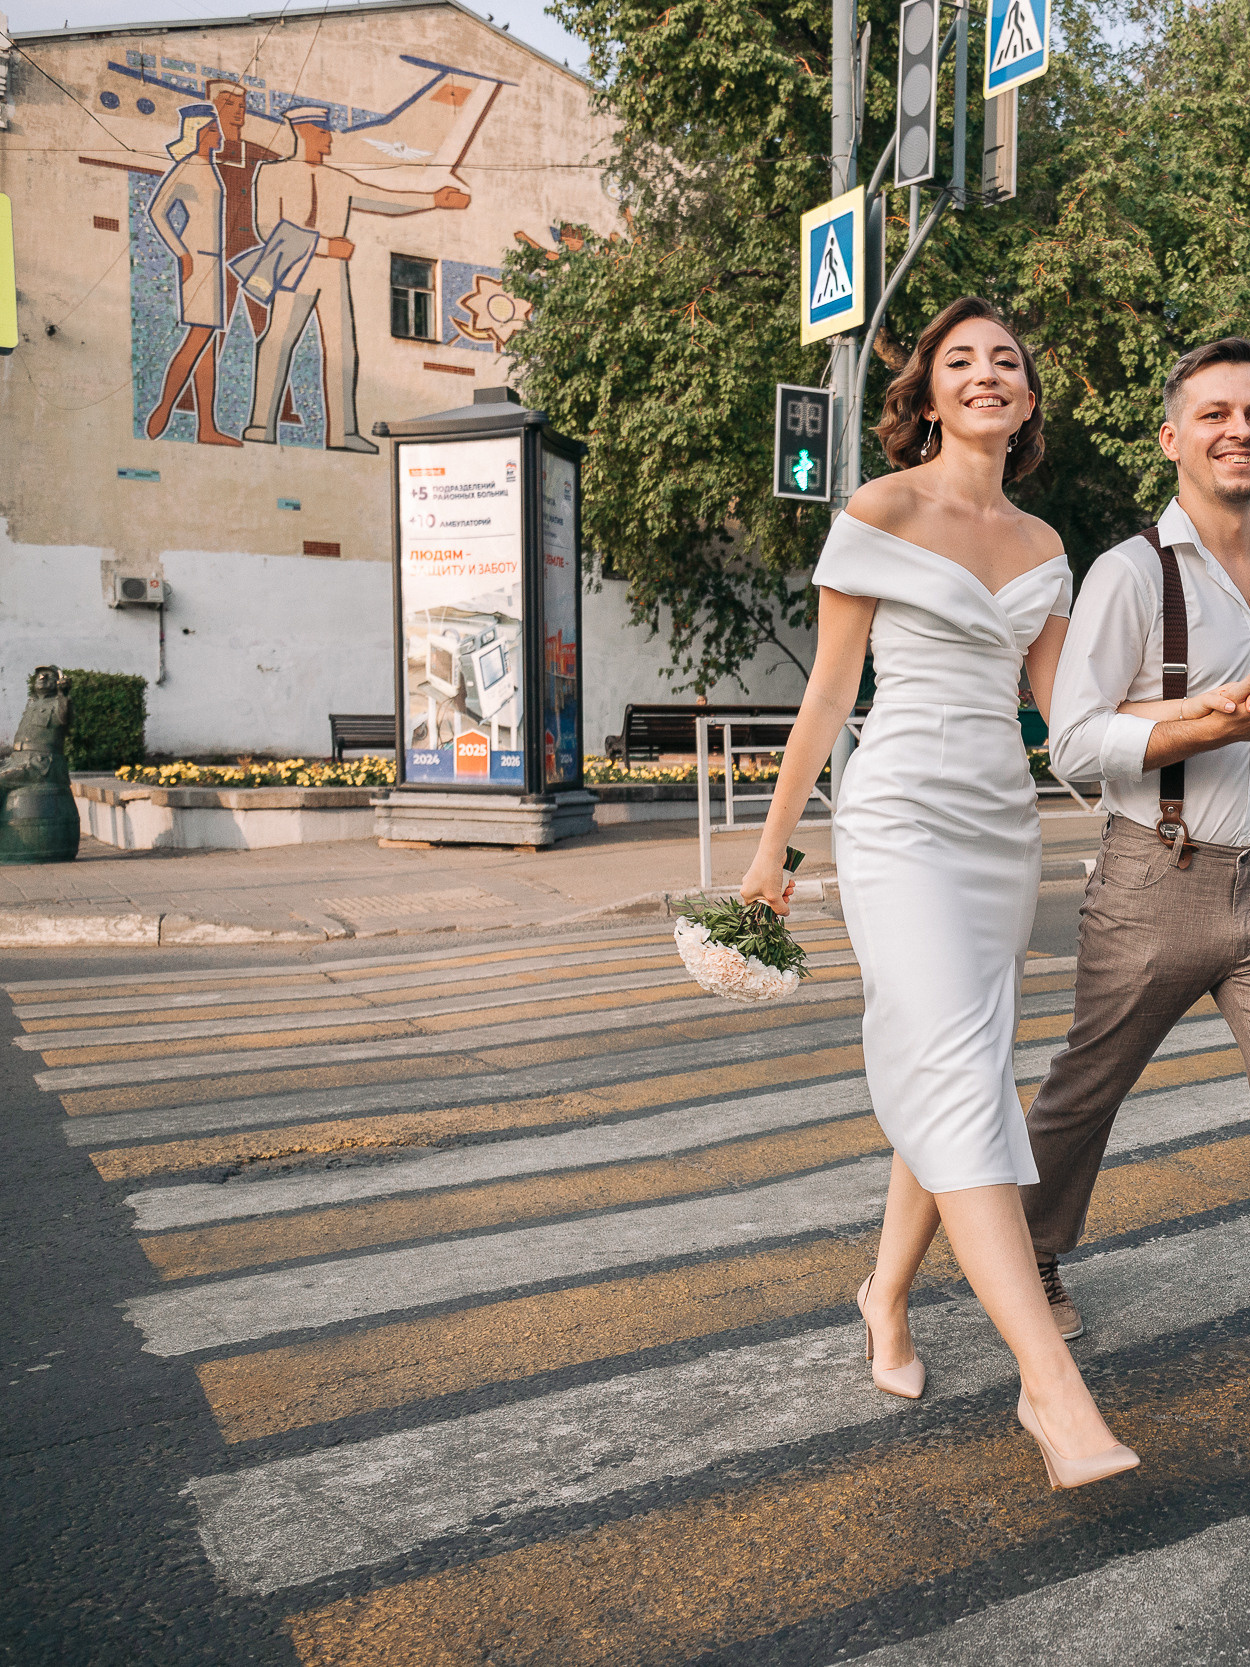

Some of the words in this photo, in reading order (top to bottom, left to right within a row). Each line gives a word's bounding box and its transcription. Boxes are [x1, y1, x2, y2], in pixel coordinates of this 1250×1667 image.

[432, 480, 496, 493] ПОДРАЗДЕЛЕНИЙ
[411, 486, 428, 501] +5
[432, 490, 475, 501] РАЙОННЫХ
[476, 489, 509, 499] БОЛЬНИЦ
[409, 513, 436, 528] +10
[439, 517, 491, 528] АМБУЛАТОРИЙ
[409, 550, 463, 562] ЛЮДЯМ
[468, 564, 476, 575] И
[479, 561, 518, 575] ЗАБОТУ
[458, 743, 487, 757] 2025
[413, 754, 440, 765] 2024
[500, 755, 520, 767] 2026
